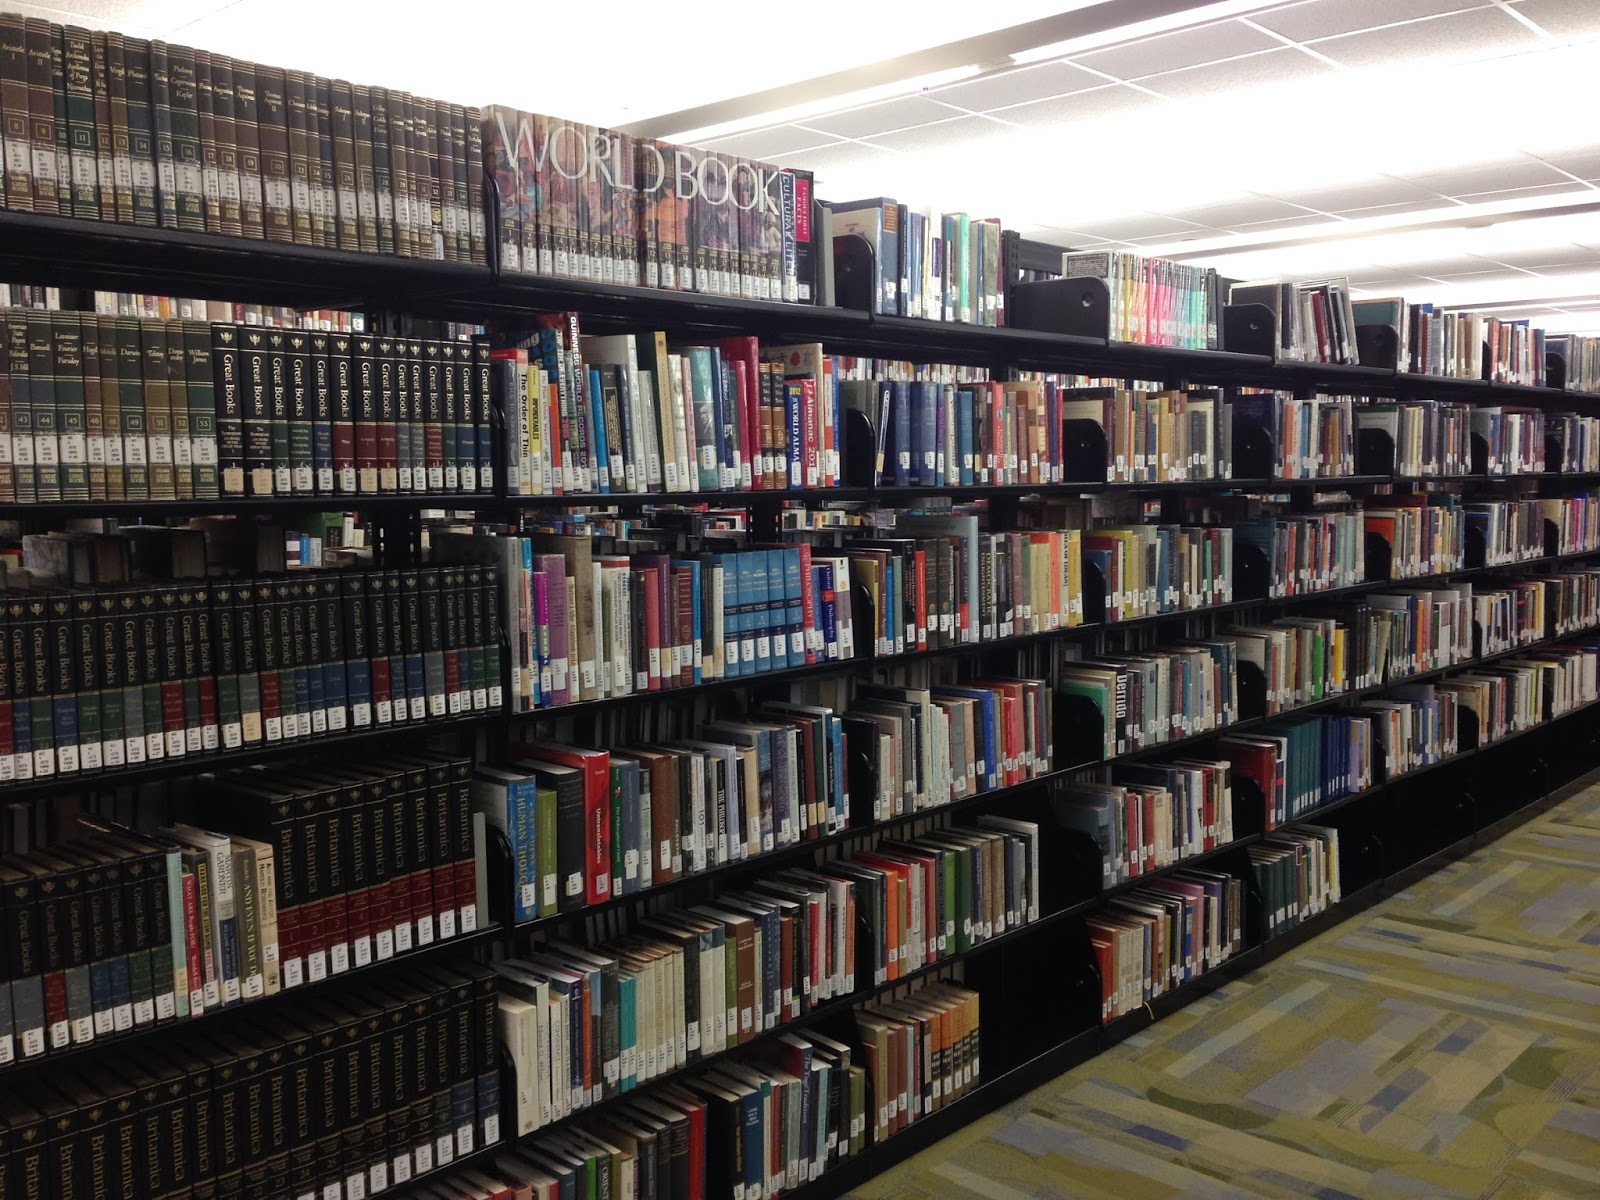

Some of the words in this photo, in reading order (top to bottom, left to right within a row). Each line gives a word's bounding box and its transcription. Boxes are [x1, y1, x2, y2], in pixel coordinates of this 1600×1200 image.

[495, 111, 665, 193] WORLD
[675, 150, 780, 216] BOOK
[570, 316, 580, 366] GUINNESS
[224, 354, 233, 382] Great
[252, 356, 261, 383] Great
[272, 358, 282, 384] Great
[294, 359, 303, 385] Great
[317, 360, 326, 386] Great
[340, 362, 348, 387] Great
[362, 362, 370, 387] Great
[382, 364, 390, 388] Great
[398, 364, 406, 388] Great
[412, 365, 420, 390] Great
[429, 366, 438, 390] Great
[520, 374, 528, 390] The
[226, 384, 235, 414] Books
[559, 374, 568, 416] EVERYTHING
[574, 368, 582, 402] WORLD
[254, 386, 263, 416] Books
[274, 387, 284, 416] Books
[295, 388, 304, 416] Books
[318, 388, 327, 416] Books
[340, 390, 349, 418] Books
[362, 390, 372, 418] Books
[382, 390, 392, 418] Books
[430, 392, 438, 419] Books
[446, 393, 454, 420] Books
[464, 394, 472, 420] Books
[482, 394, 490, 420] Books
[68, 416, 78, 424] 45
[522, 424, 528, 434] of
[578, 405, 586, 448] RECORDS
[808, 447, 816, 468] 201
[804, 563, 814, 618] PHILOSOPHY
[34, 628, 44, 657] Great
[125, 621, 134, 649] Great
[355, 628, 363, 655] Books
[36, 660, 46, 692] Books
[127, 652, 137, 682] Books
[1116, 674, 1127, 718] Derrida
[416, 797, 426, 862] Britannica
[438, 793, 448, 857] Britannica
[460, 788, 469, 852] Britannica
[517, 798, 526, 840] HUMAN
[353, 814, 362, 881] Britannica
[374, 809, 384, 876] Britannica
[394, 803, 404, 868] Britannica
[281, 828, 294, 899] Britannica
[305, 824, 317, 894] Britannica
[329, 818, 340, 887] Britannica
[216, 852, 226, 894] GARDNER
[244, 884, 252, 904] AND
[245, 907, 254, 931] EVEN
[248, 934, 256, 944] IF
[248, 945, 256, 963] YOU
[485, 1002, 493, 1065] Britannica
[417, 1026, 426, 1092] Britannica
[297, 1068, 308, 1137] Britannica
[172, 1108, 184, 1181] Britannica
